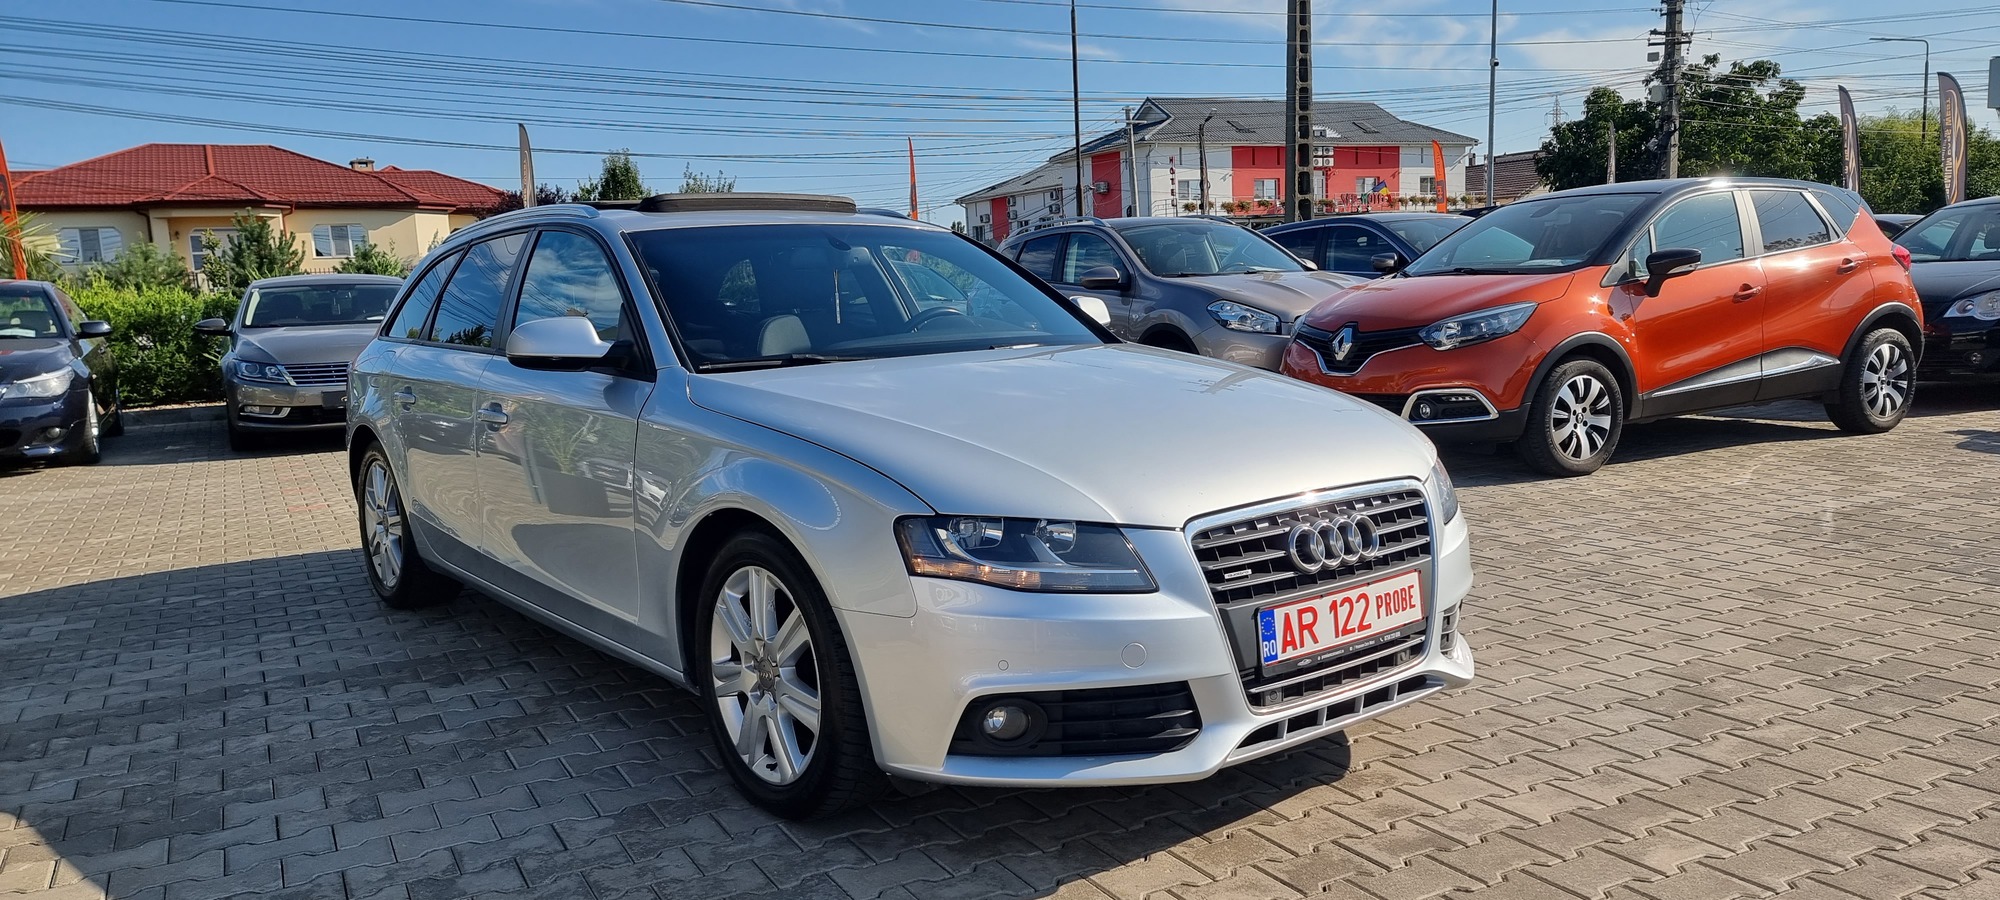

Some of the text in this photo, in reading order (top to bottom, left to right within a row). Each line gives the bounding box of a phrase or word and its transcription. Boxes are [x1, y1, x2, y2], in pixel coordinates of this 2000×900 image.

[1281, 584, 1417, 655] AR 122 PROBE
[1263, 639, 1277, 658] RO
